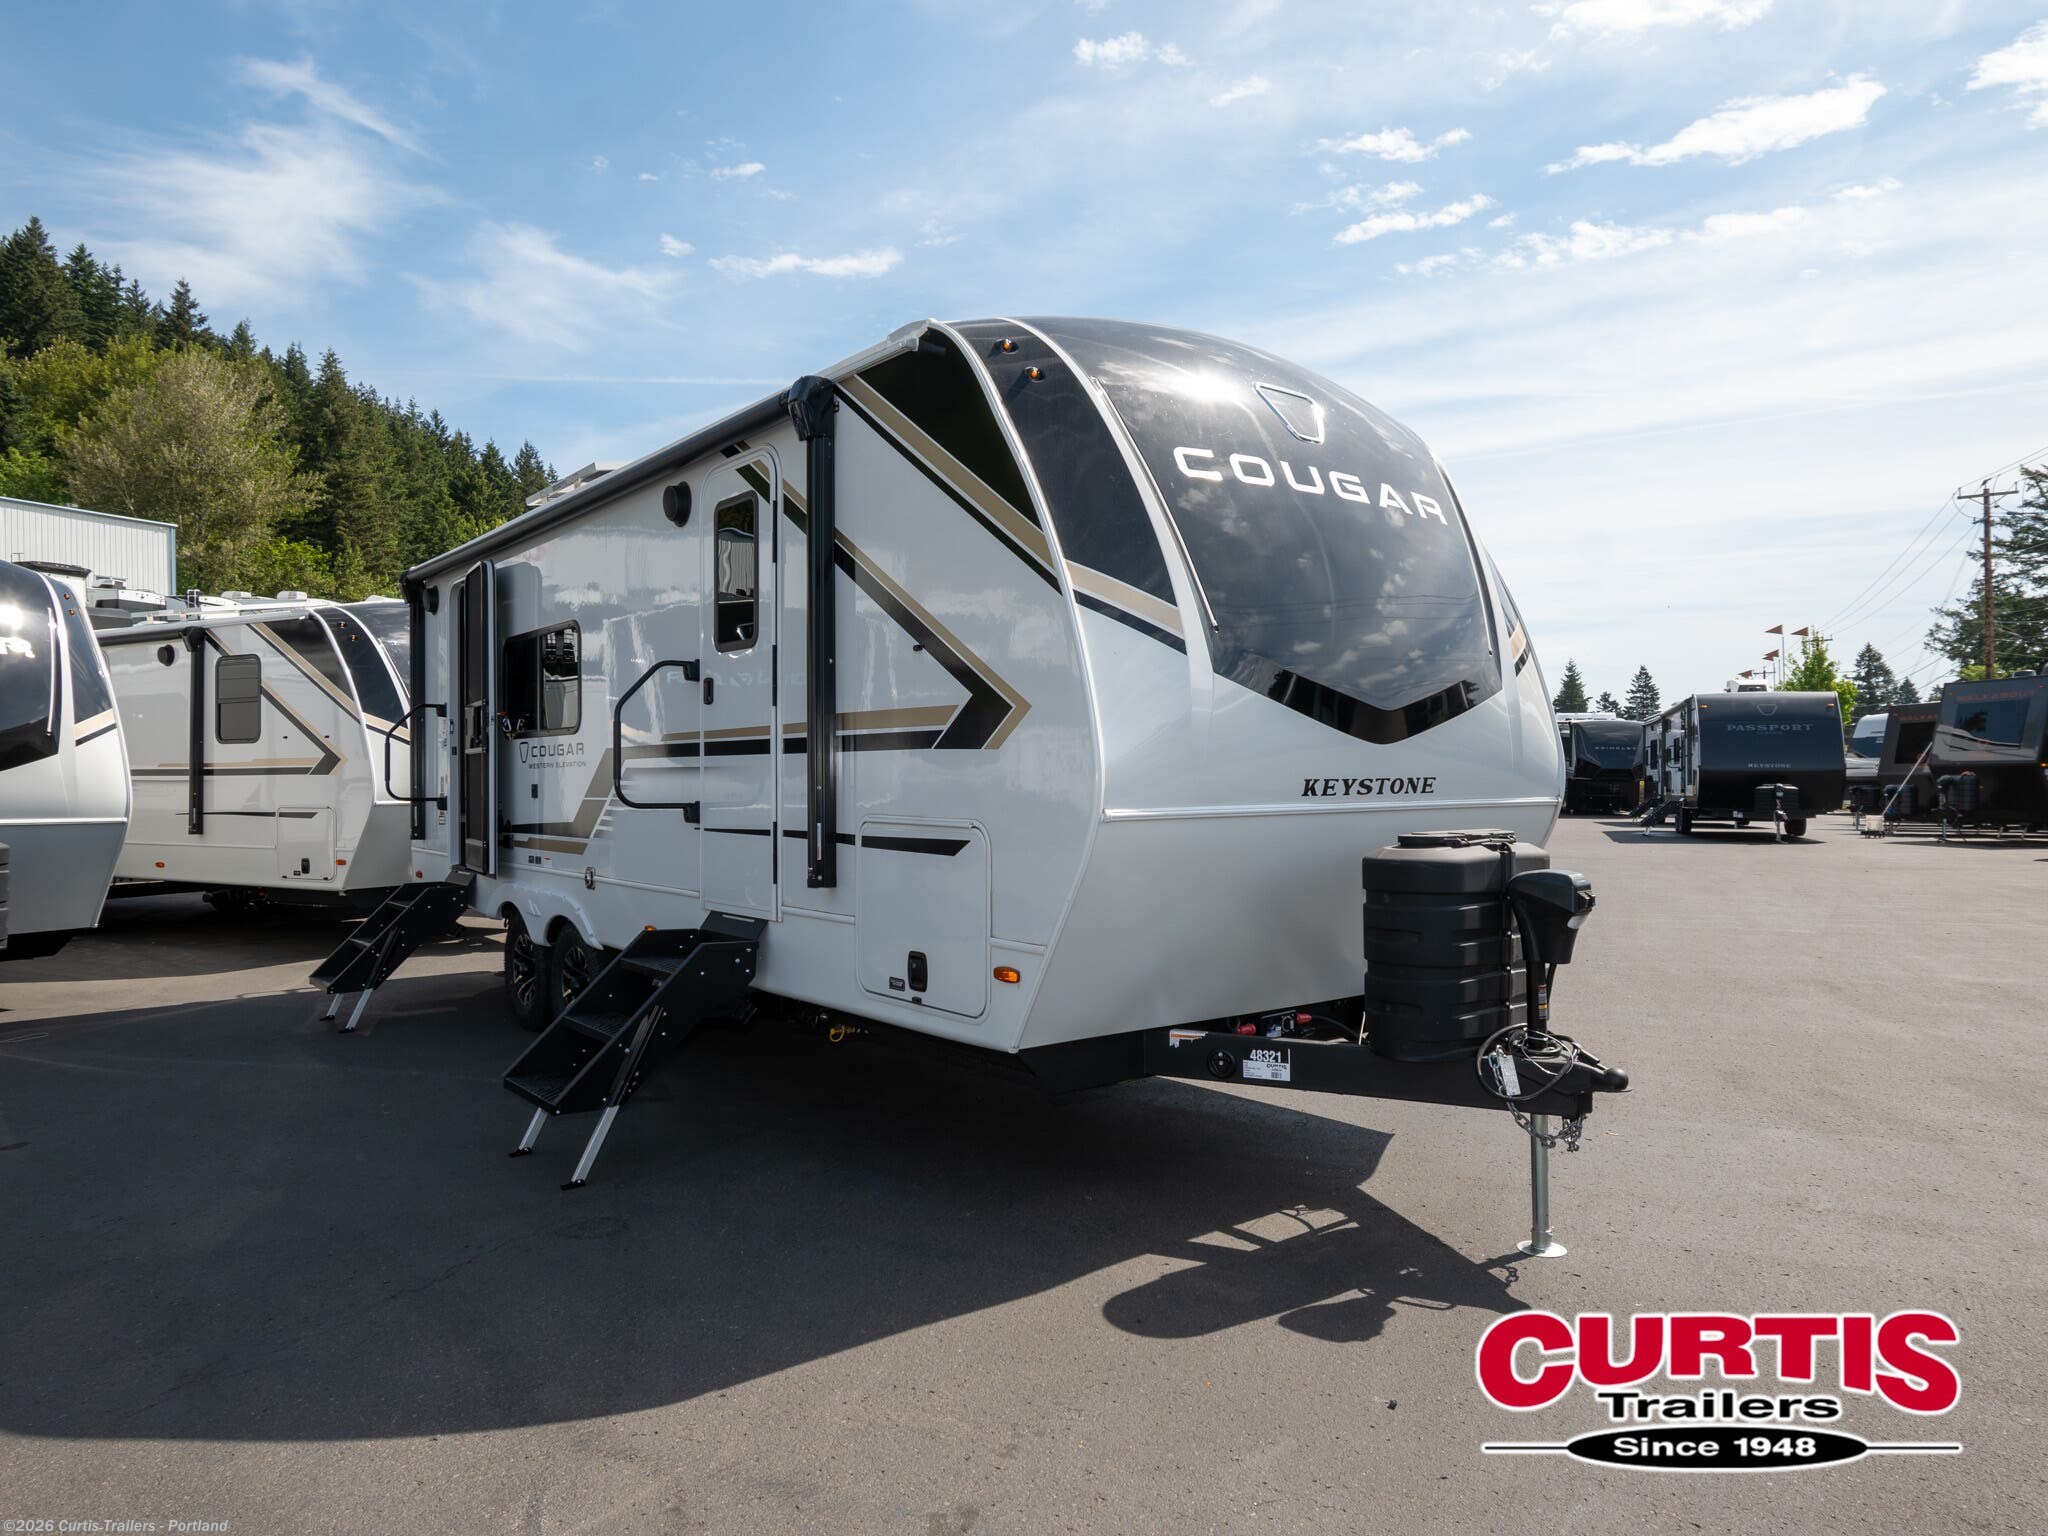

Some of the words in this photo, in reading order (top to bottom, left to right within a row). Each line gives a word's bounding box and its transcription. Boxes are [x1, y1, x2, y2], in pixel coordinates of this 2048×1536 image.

[1173, 446, 1448, 525] COUGAR
[531, 742, 584, 758] COUGAR
[1301, 777, 1437, 797] KEYSTONE
[1250, 1049, 1282, 1063] 48321
